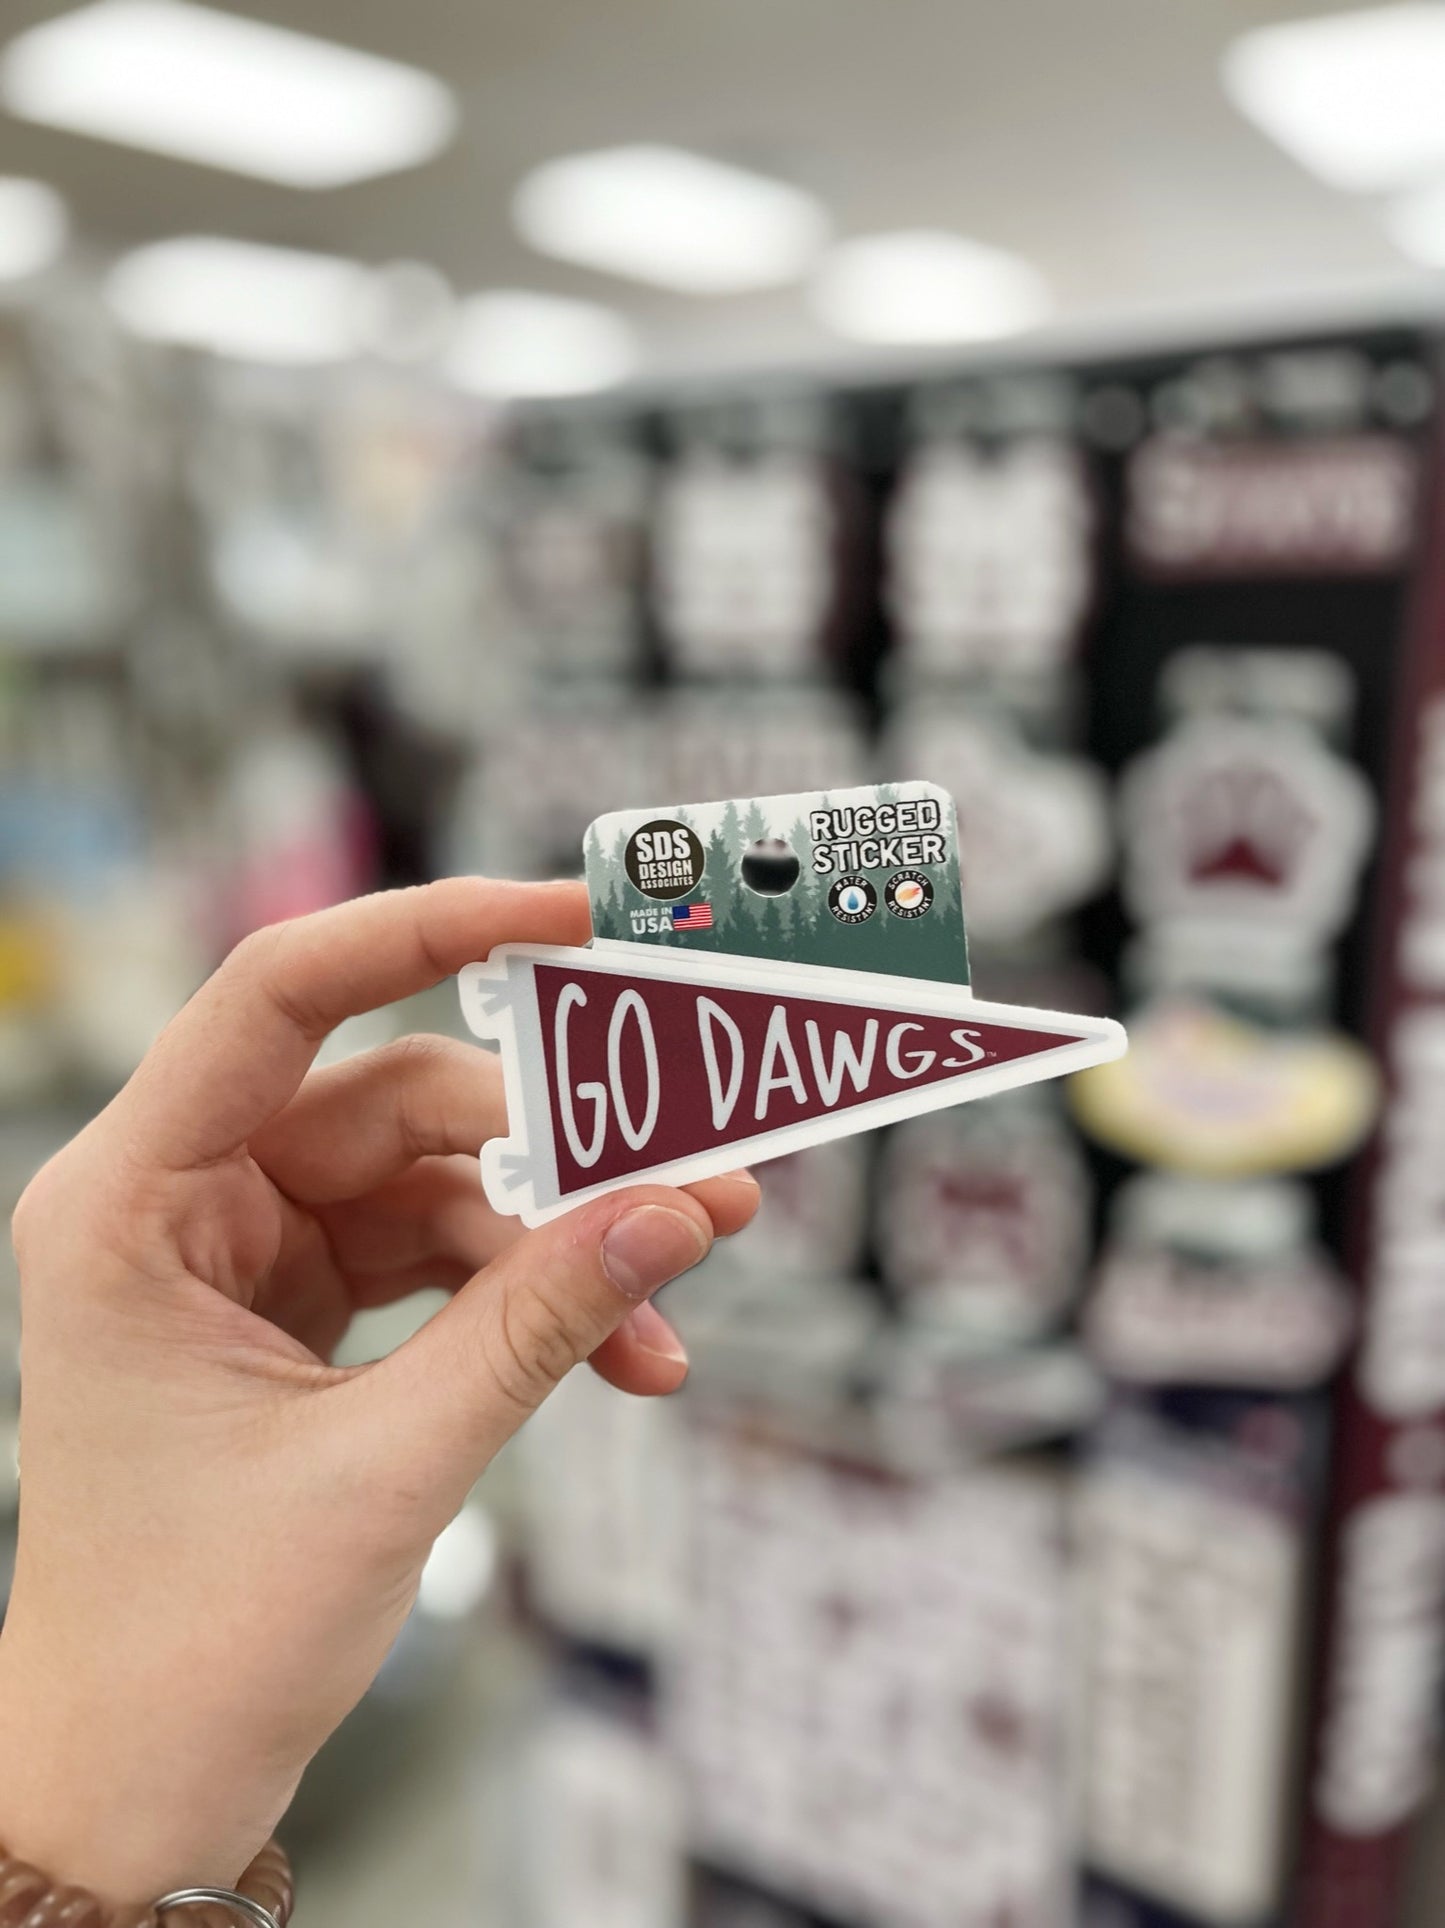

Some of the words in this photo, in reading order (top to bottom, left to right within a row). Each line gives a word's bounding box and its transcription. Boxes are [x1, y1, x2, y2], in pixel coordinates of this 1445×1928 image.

[810, 799, 941, 841] RUGGED
[635, 828, 690, 863] SDS
[812, 832, 946, 875] STICKER
[638, 859, 693, 880] DESIGN
[888, 871, 929, 890] SCRATCH
[640, 876, 694, 890] ASSOCIATES
[835, 877, 868, 892] WATER
[630, 908, 659, 918] MADE
[661, 906, 673, 915] IN
[831, 901, 876, 925] RESISTANT
[887, 896, 932, 920] RESISTANT
[632, 916, 675, 935] USA
[555, 983, 660, 1169] GO
[696, 996, 986, 1131] DAWGS
